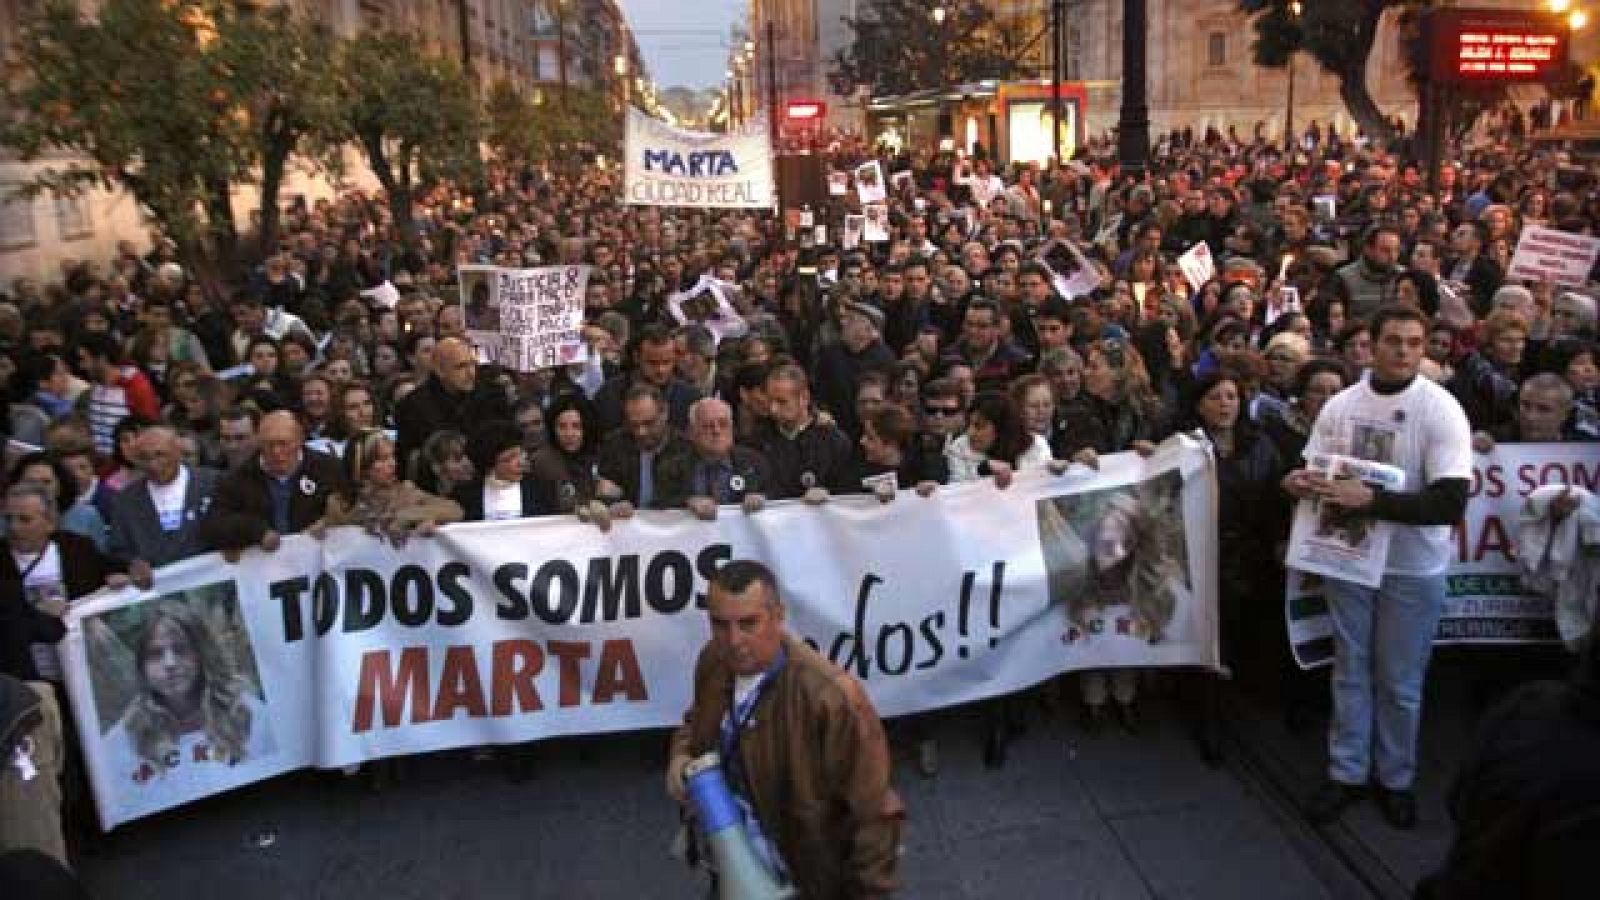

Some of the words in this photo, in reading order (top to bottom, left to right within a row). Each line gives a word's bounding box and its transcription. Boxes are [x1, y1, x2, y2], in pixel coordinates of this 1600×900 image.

[632, 179, 701, 202] CIUDAD
[707, 180, 760, 203] REAL
[643, 149, 738, 177] MARTA
[269, 561, 475, 643] TODOS
[804, 561, 1006, 680] dos!!
[351, 638, 648, 734] MARTA
